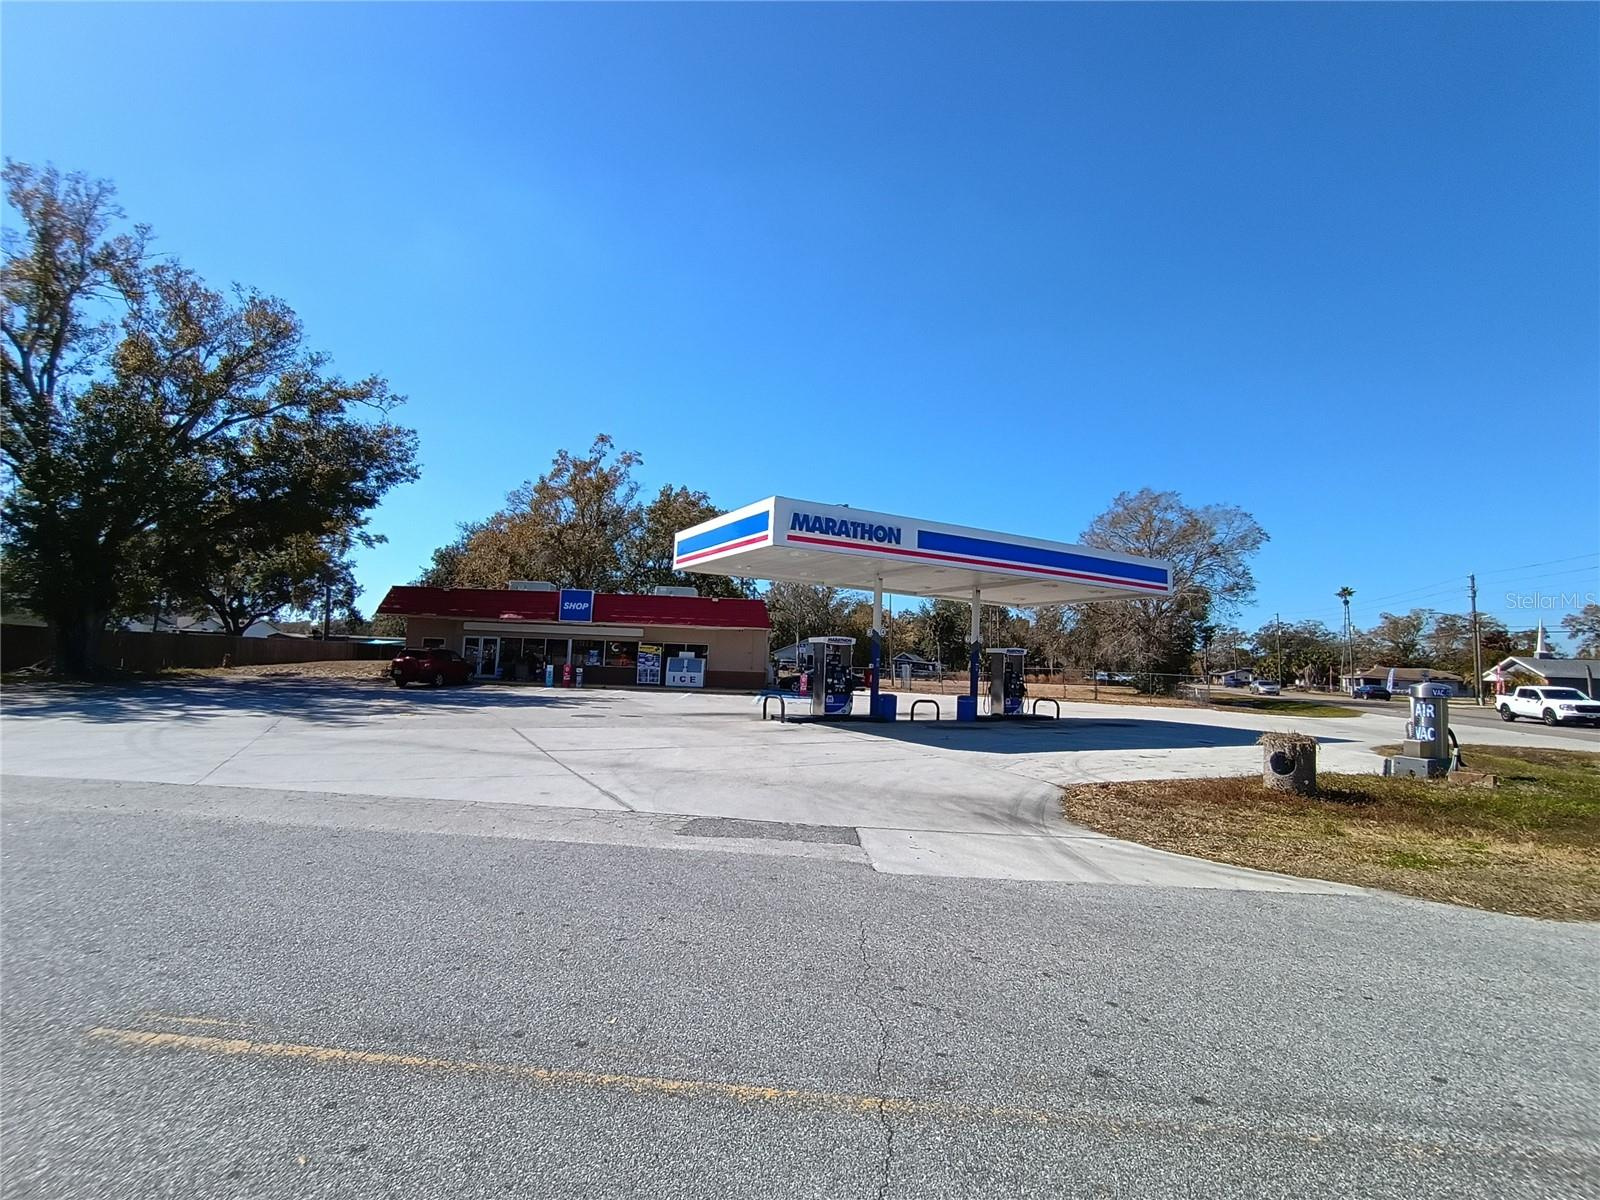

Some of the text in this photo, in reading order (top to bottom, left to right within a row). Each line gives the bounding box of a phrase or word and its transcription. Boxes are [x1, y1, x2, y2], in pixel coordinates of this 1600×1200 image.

[790, 512, 902, 545] MARATHON
[563, 601, 589, 610] SHOP
[672, 675, 697, 684] ICE
[1415, 703, 1435, 718] AIR
[1415, 726, 1435, 741] VAC
